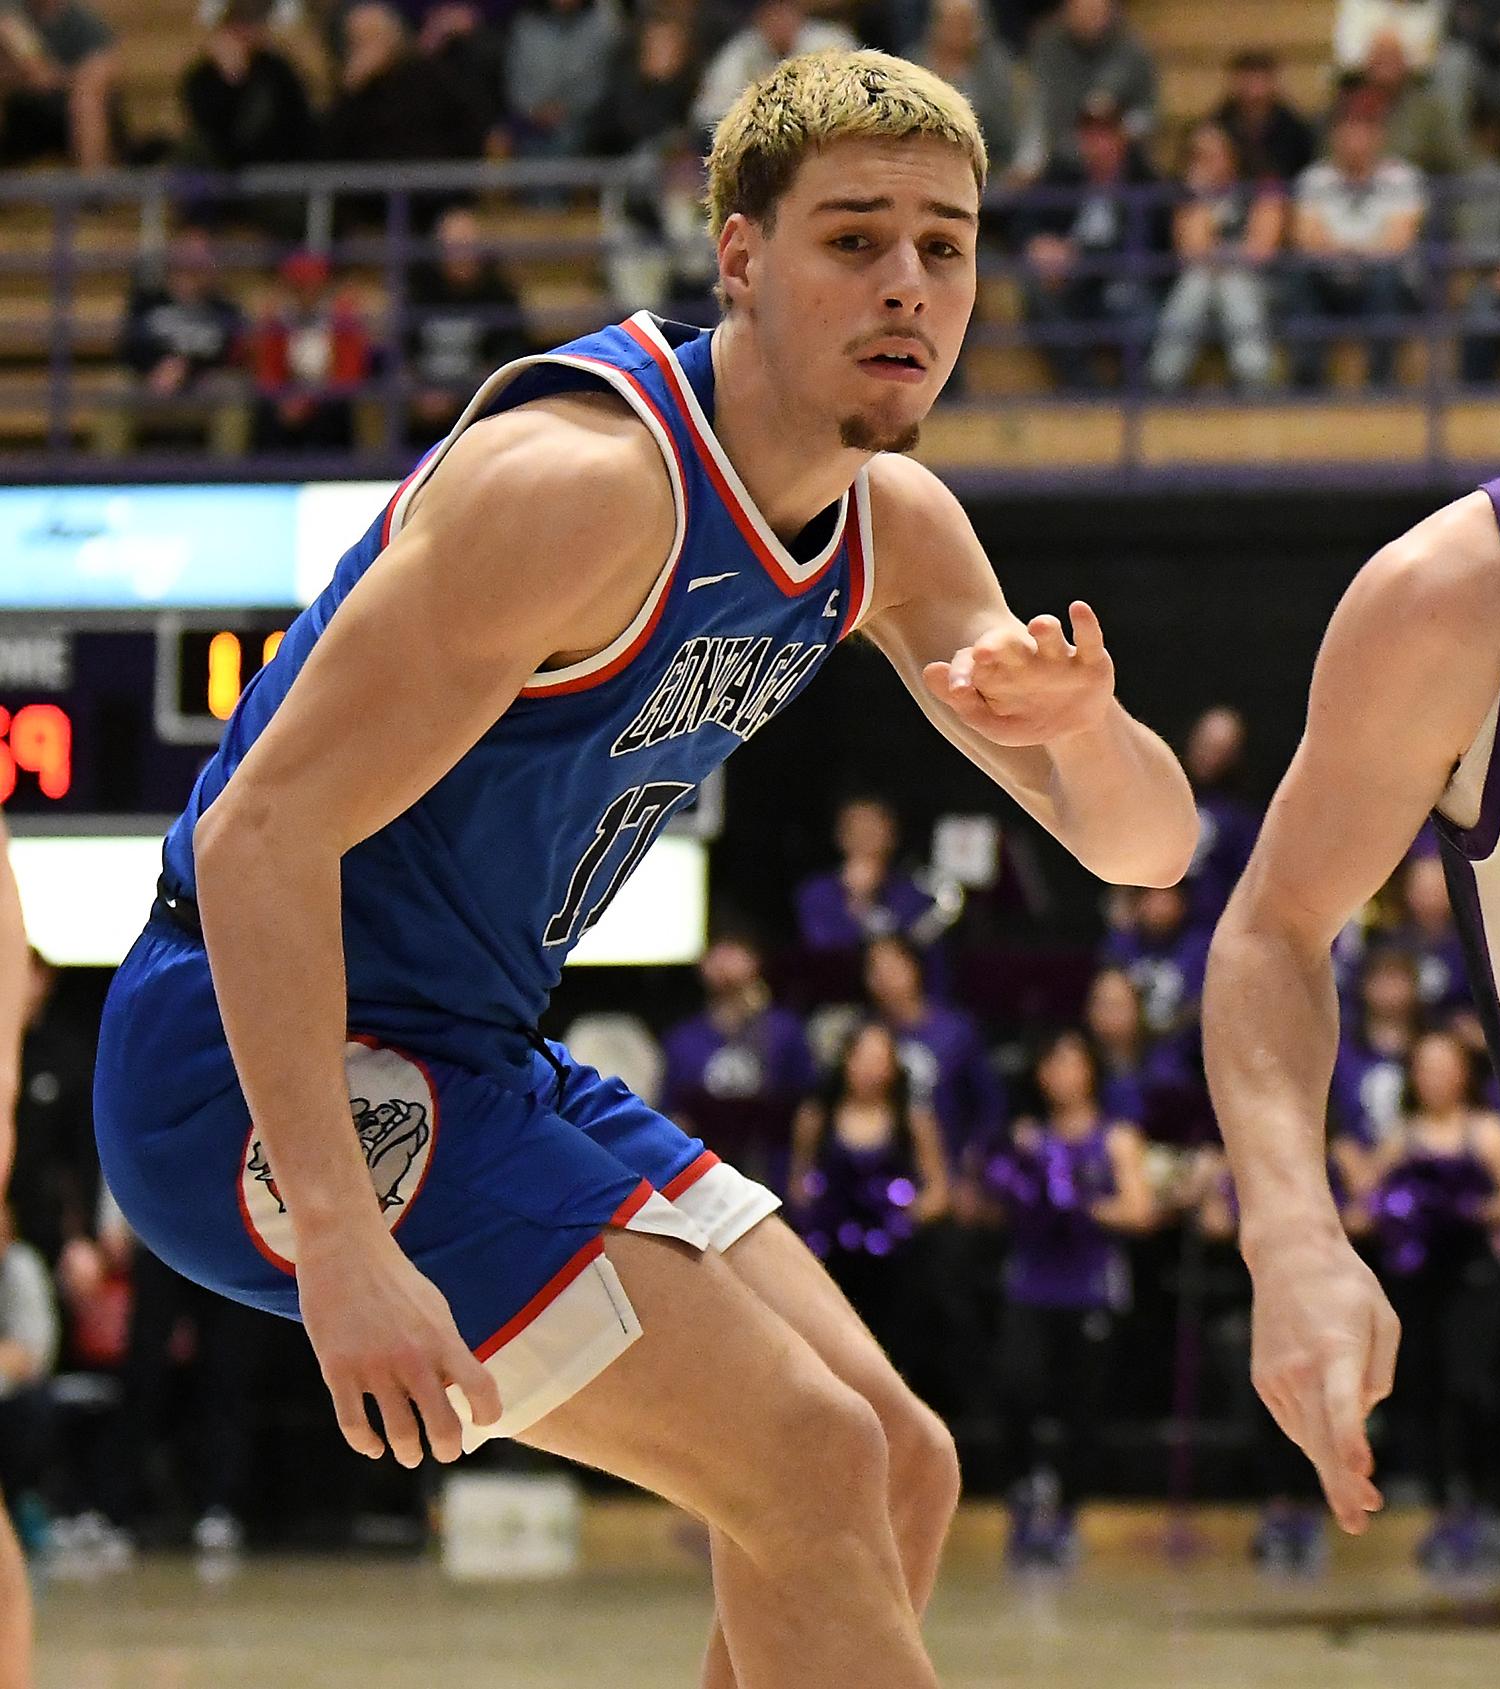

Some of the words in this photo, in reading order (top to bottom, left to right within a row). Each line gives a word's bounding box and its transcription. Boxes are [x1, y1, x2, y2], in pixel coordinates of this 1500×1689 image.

[0, 702, 72, 801] 9
[609, 636, 828, 758] GONZAGA
[541, 780, 696, 946] 17
